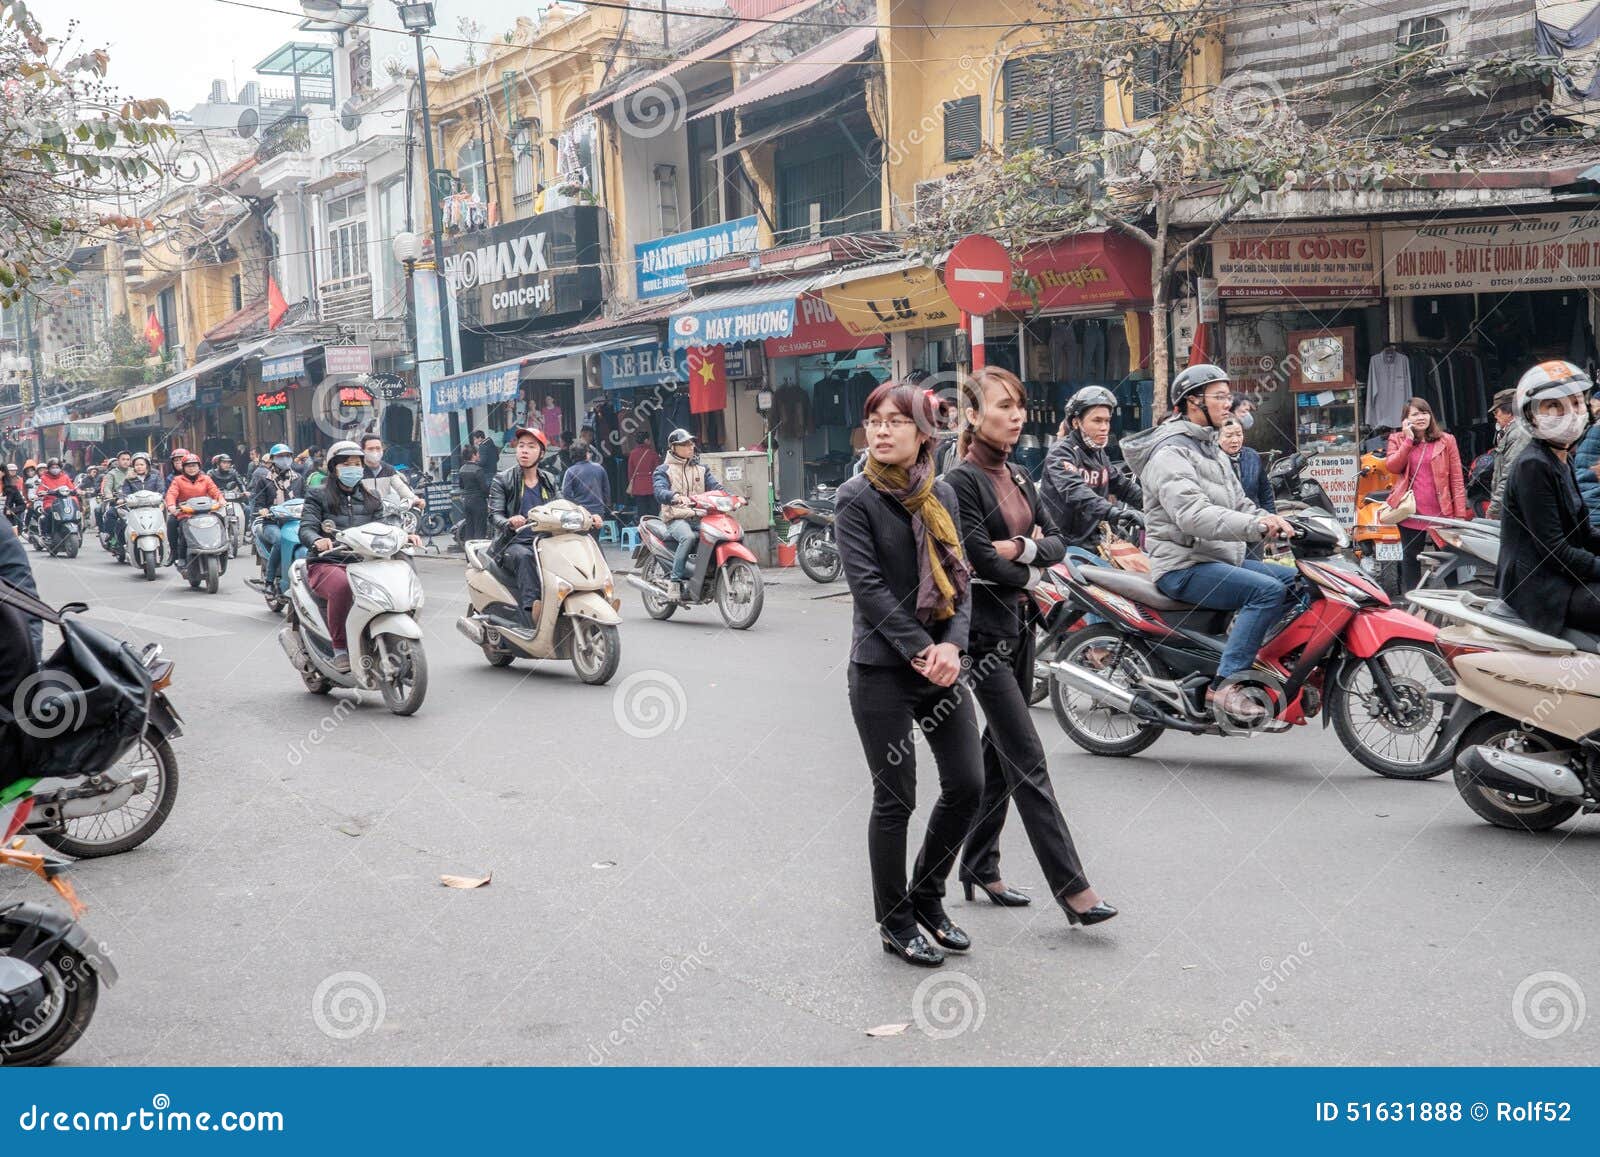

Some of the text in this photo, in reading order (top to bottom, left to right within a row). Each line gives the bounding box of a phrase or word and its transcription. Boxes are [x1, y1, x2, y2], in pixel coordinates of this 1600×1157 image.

[1229, 236, 1366, 260] MINH CÔNG
[1397, 247, 1417, 276] BÁN
[1420, 245, 1446, 275] BUÔN
[1456, 243, 1477, 273] BÁN
[1524, 241, 1538, 270] ÁO
[493, 280, 551, 310] concept
[1429, 280, 1452, 289] HÀNG
[682, 318, 692, 332] 6
[706, 309, 789, 340] MAY PHƯƠNG
